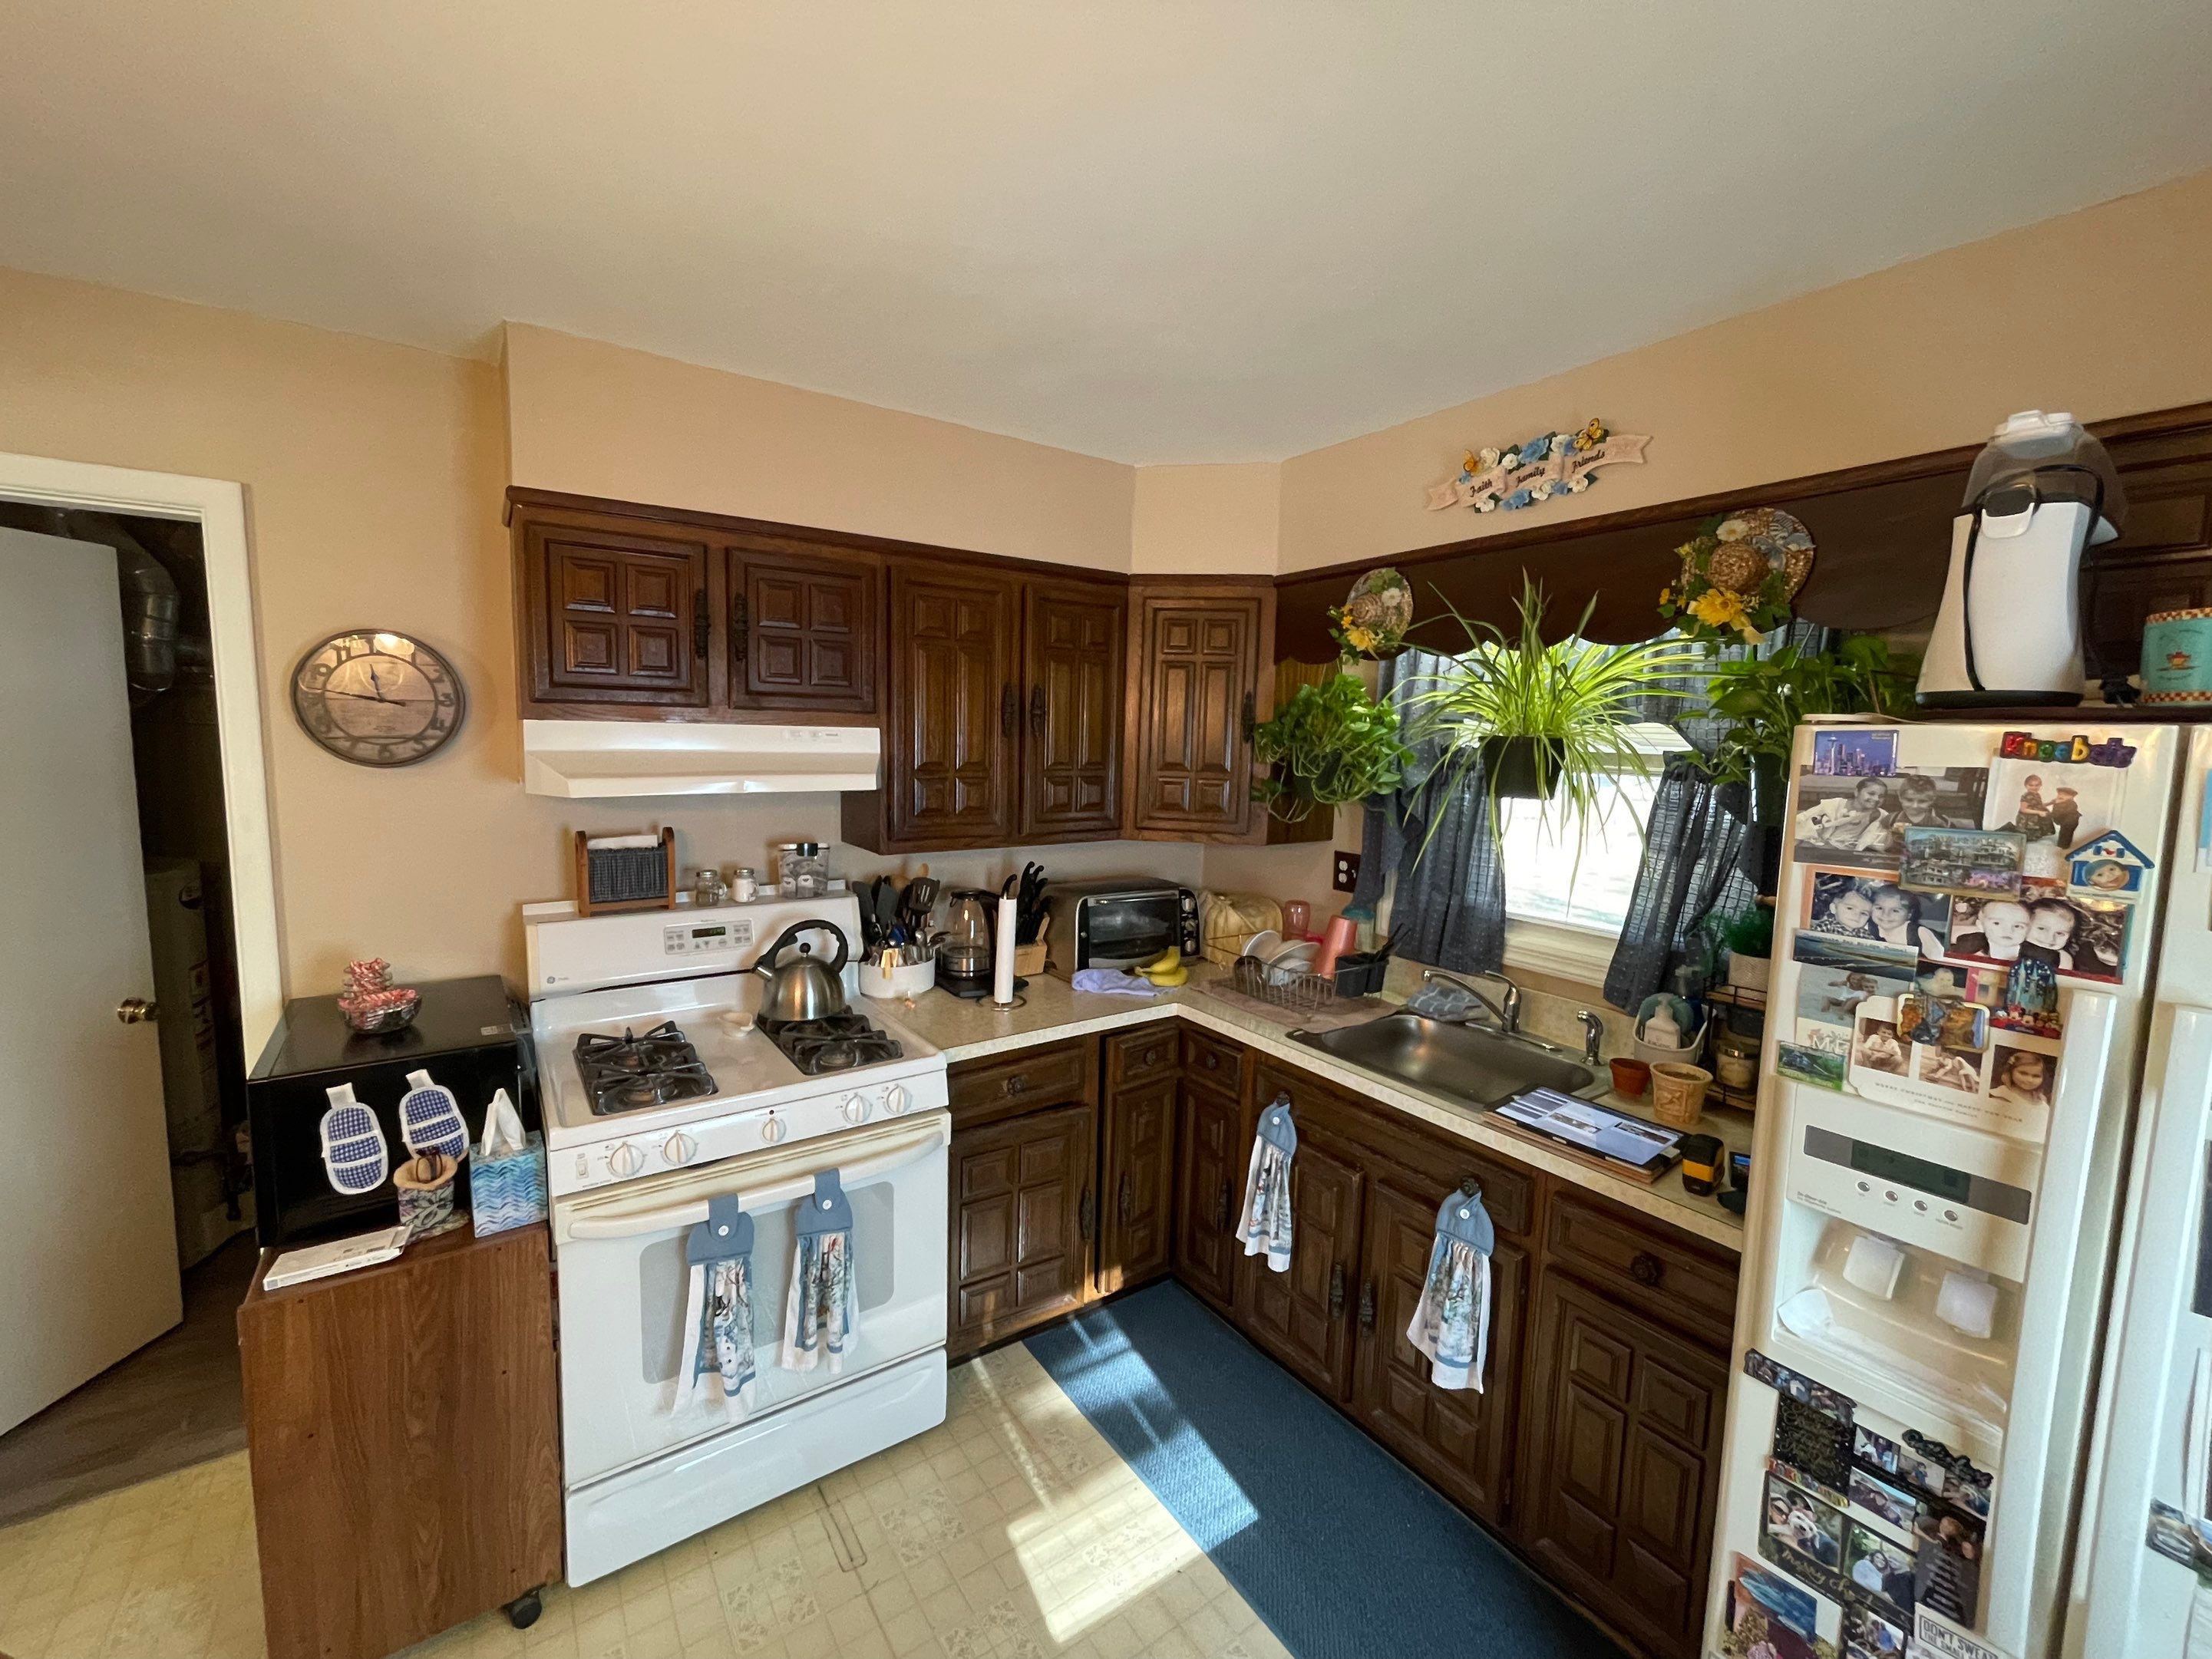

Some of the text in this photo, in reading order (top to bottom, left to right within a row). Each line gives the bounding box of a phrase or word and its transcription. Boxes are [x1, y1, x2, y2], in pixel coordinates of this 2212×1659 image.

[1470, 450, 1606, 497] Faith Family Friends
